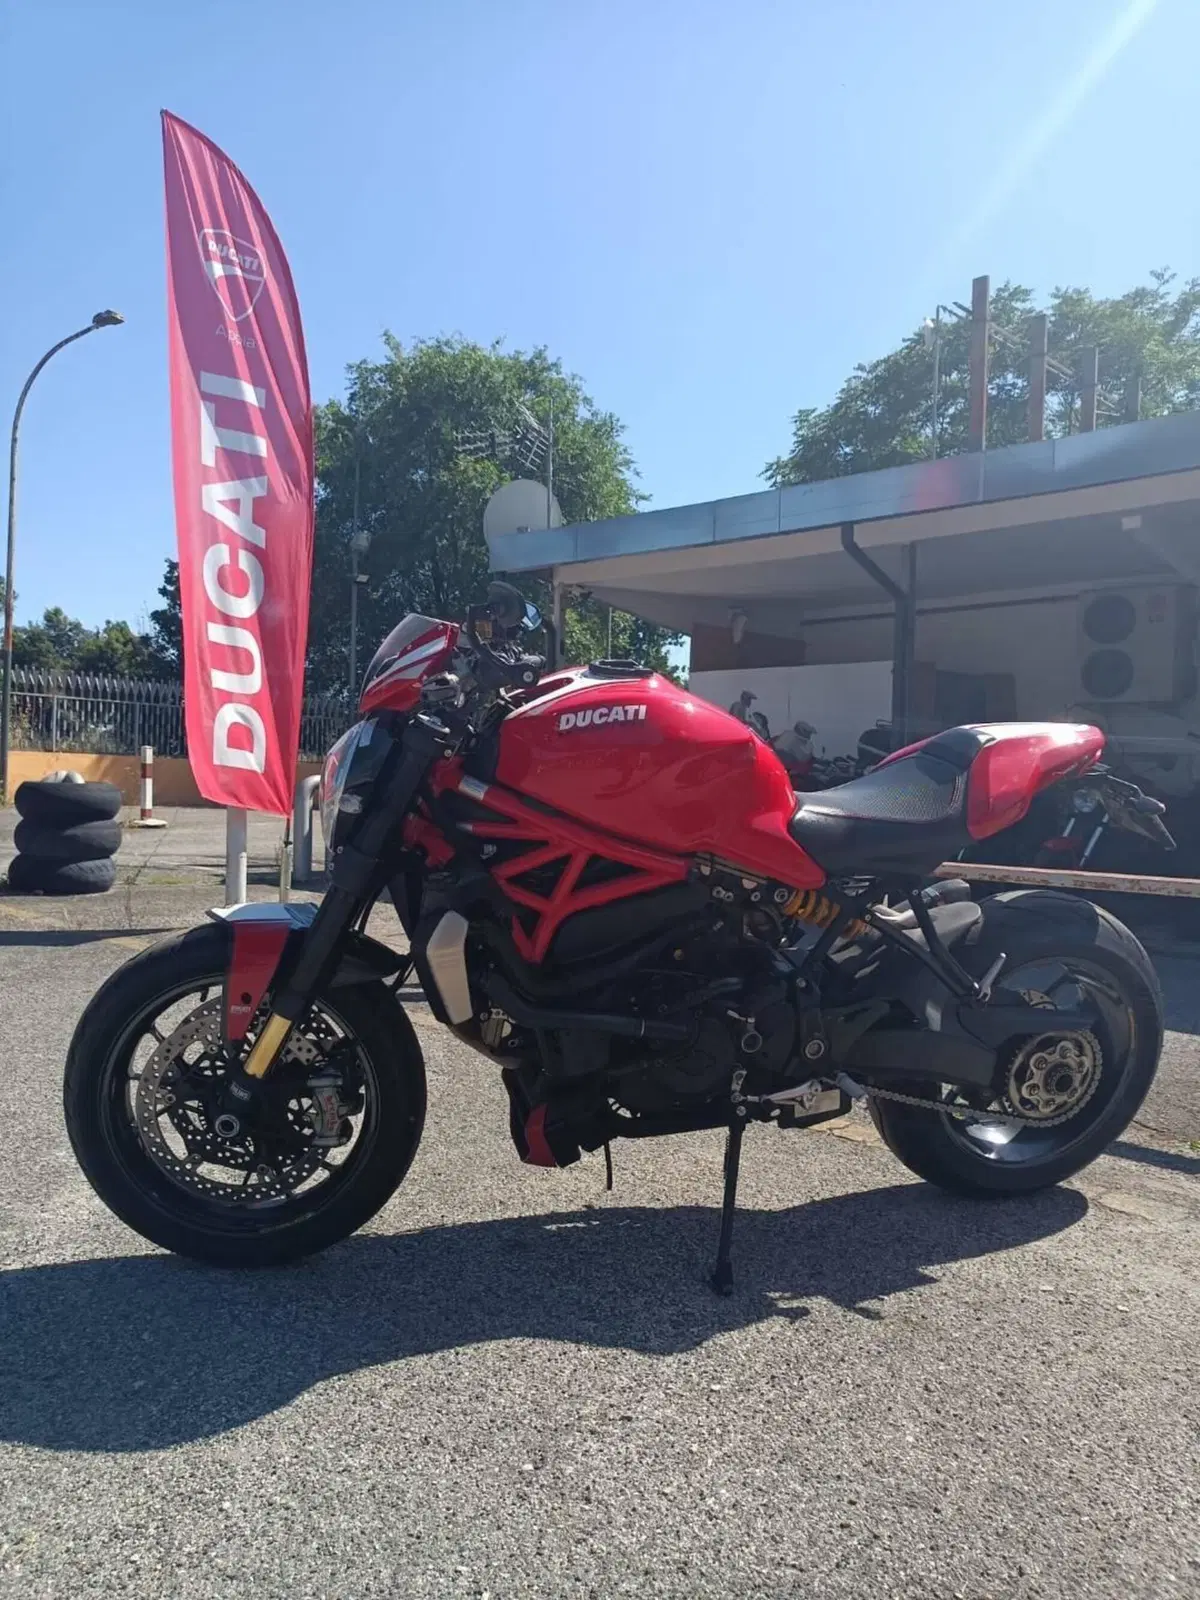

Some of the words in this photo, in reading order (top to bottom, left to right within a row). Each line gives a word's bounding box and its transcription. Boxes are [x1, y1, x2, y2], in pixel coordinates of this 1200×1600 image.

[208, 240, 258, 271] DUCATI
[200, 370, 267, 774] DUCATI
[559, 704, 647, 731] DUCATI
